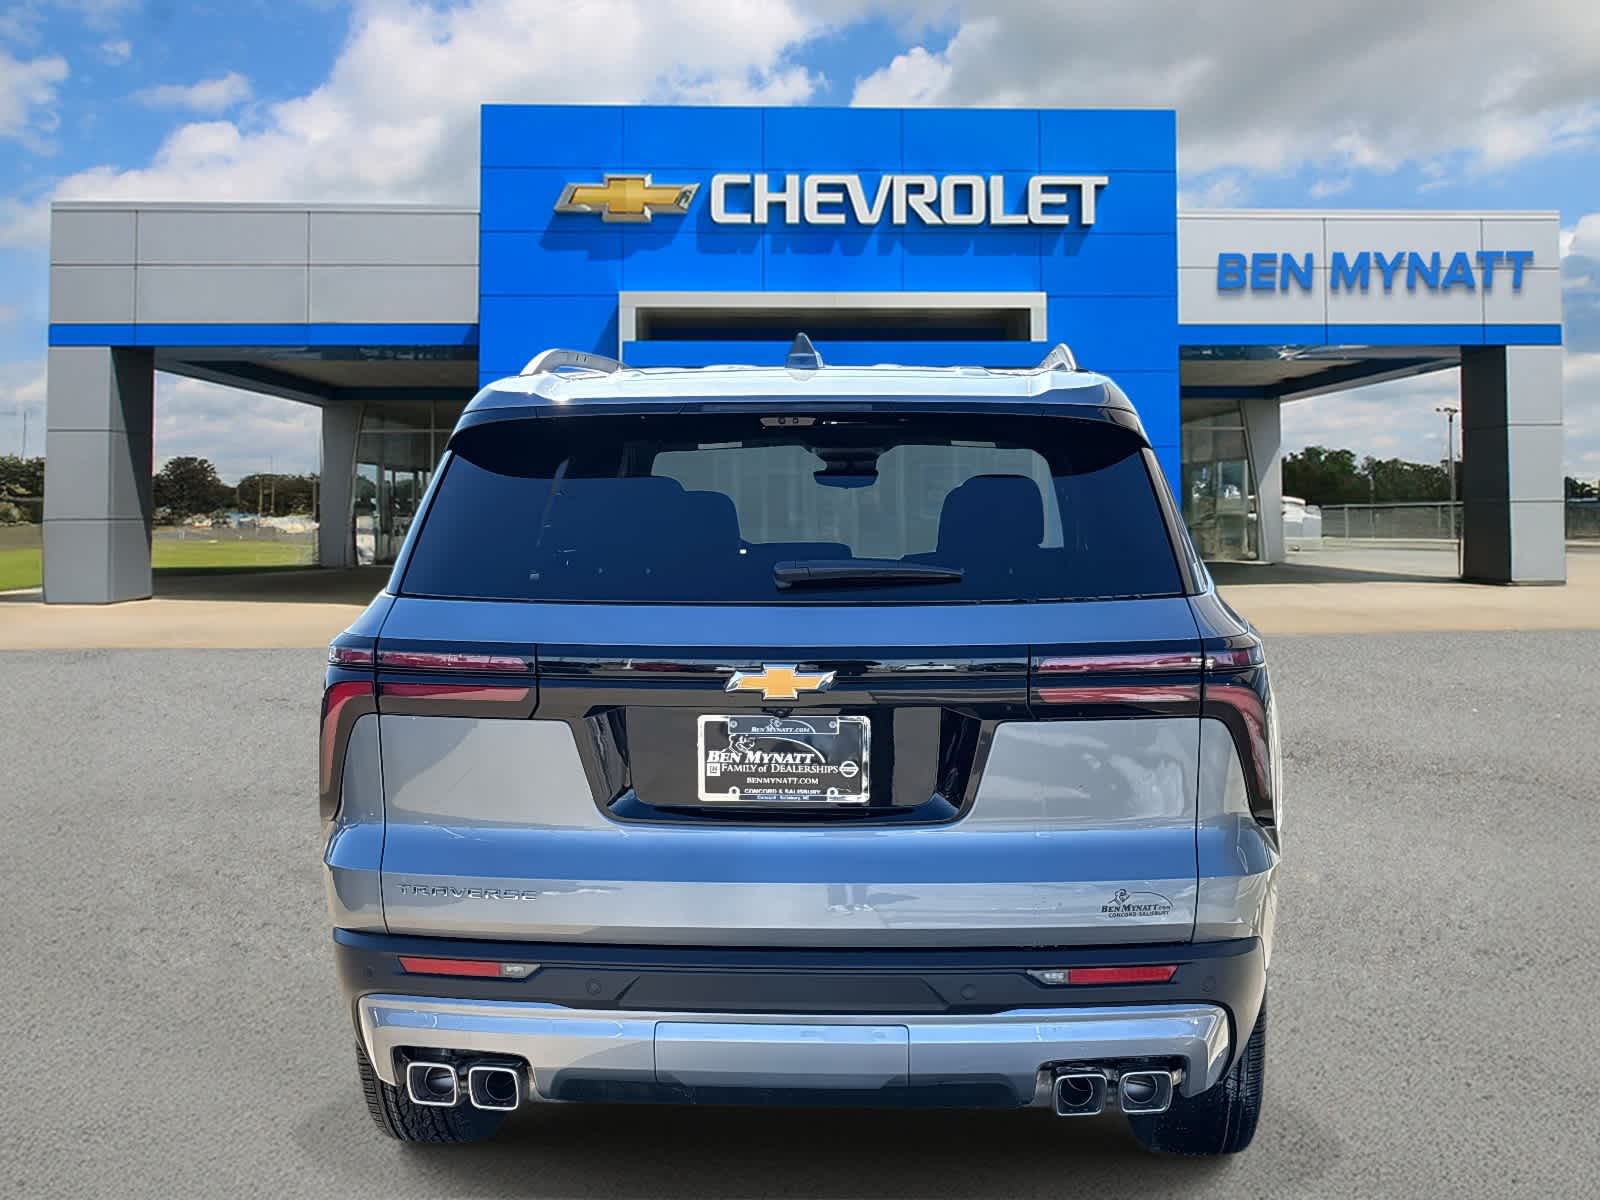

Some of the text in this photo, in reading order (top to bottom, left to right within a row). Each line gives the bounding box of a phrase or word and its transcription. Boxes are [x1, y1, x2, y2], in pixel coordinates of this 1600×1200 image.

[709, 173, 1110, 226] CHEVROLET
[1217, 250, 1535, 291] BEN MYNATT
[706, 750, 816, 764] BEN MYNATT
[721, 763, 757, 773] FAMILY
[771, 763, 839, 774] DEALERSHIPS
[395, 884, 537, 901] TRAVERSE
